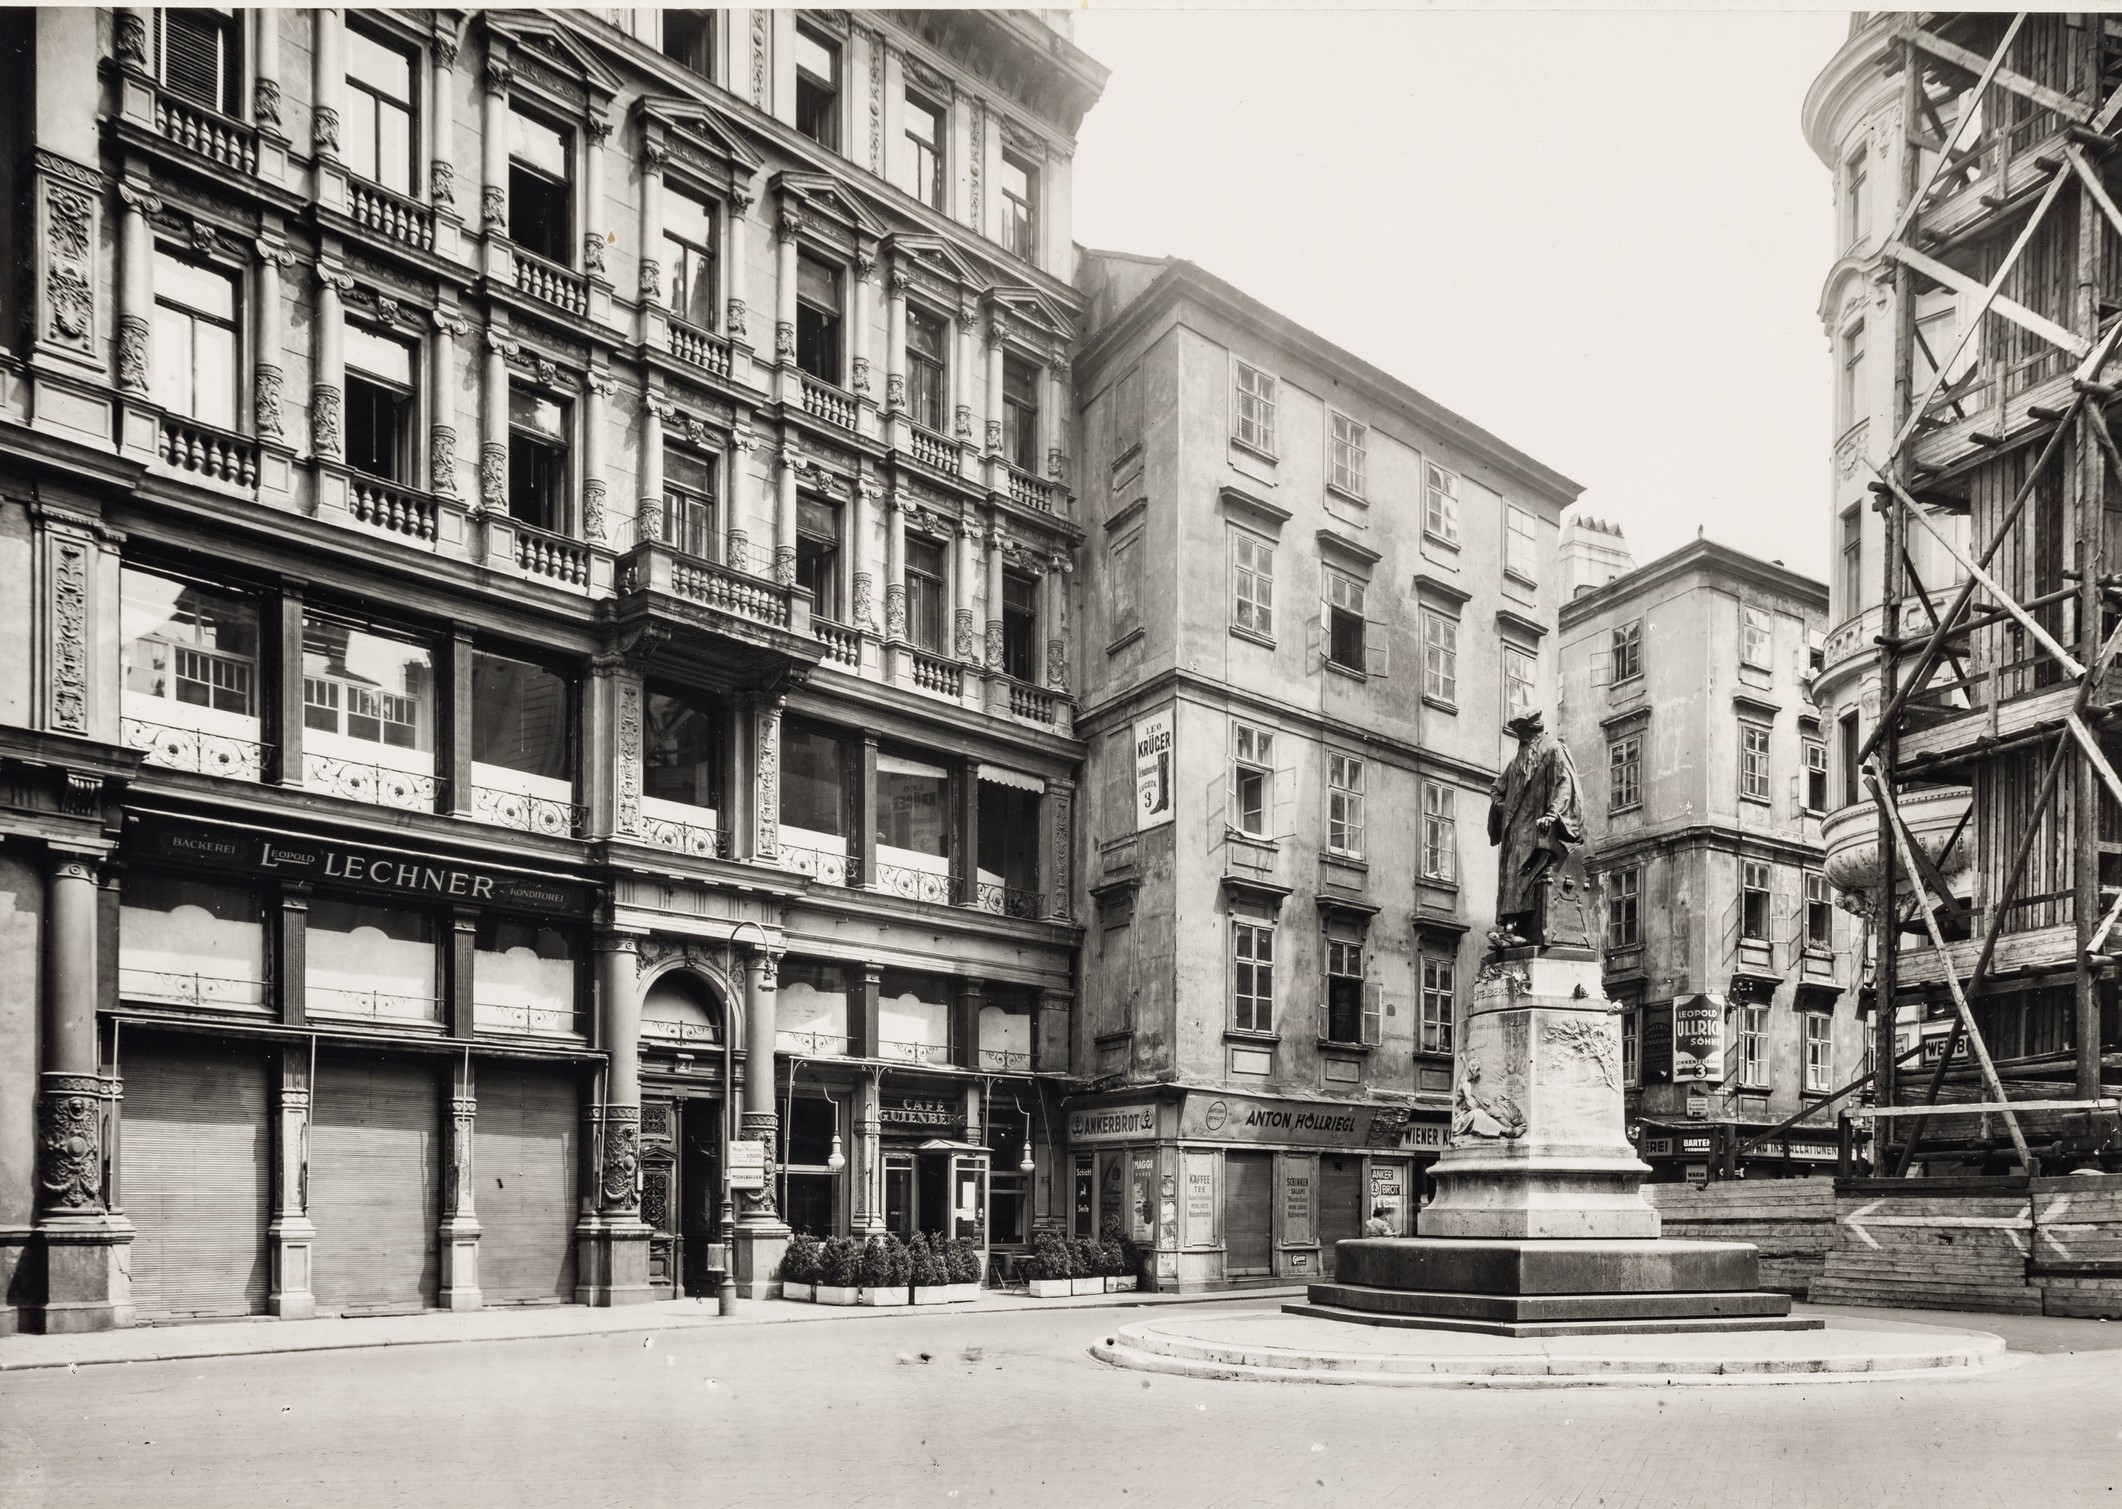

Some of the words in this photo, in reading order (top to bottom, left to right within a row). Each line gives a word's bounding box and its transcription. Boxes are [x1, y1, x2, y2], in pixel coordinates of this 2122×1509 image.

[1146, 723, 1162, 735] LEO
[1138, 731, 1171, 759] KRÜGER
[1144, 791, 1152, 808] 3
[323, 852, 494, 899] LECHNER
[509, 887, 564, 903] KONDITOREI
[1678, 1009, 1717, 1018] LEOPOLD
[1677, 1020, 1721, 1036] ULLRICH
[1690, 1037, 1720, 1046] SÖHNE
[1695, 1064, 1706, 1078] 3
[878, 1110, 966, 1126] GUTENBERG
[1084, 1113, 1140, 1135] ANKERBROT
[1245, 1110, 1292, 1129] ANTON
[1295, 1112, 1356, 1132] HÖLLRIEGL
[1405, 1127, 1439, 1146] WIENER
[1770, 1142, 1838, 1156] INSALLATIONEN
[1076, 1168, 1092, 1176] Schicht
[1134, 1160, 1153, 1170] MAGGI
[1189, 1174, 1210, 1184] KAFFEE
[1372, 1169, 1393, 1179] ANKER
[1382, 1185, 1399, 1194] BROT
